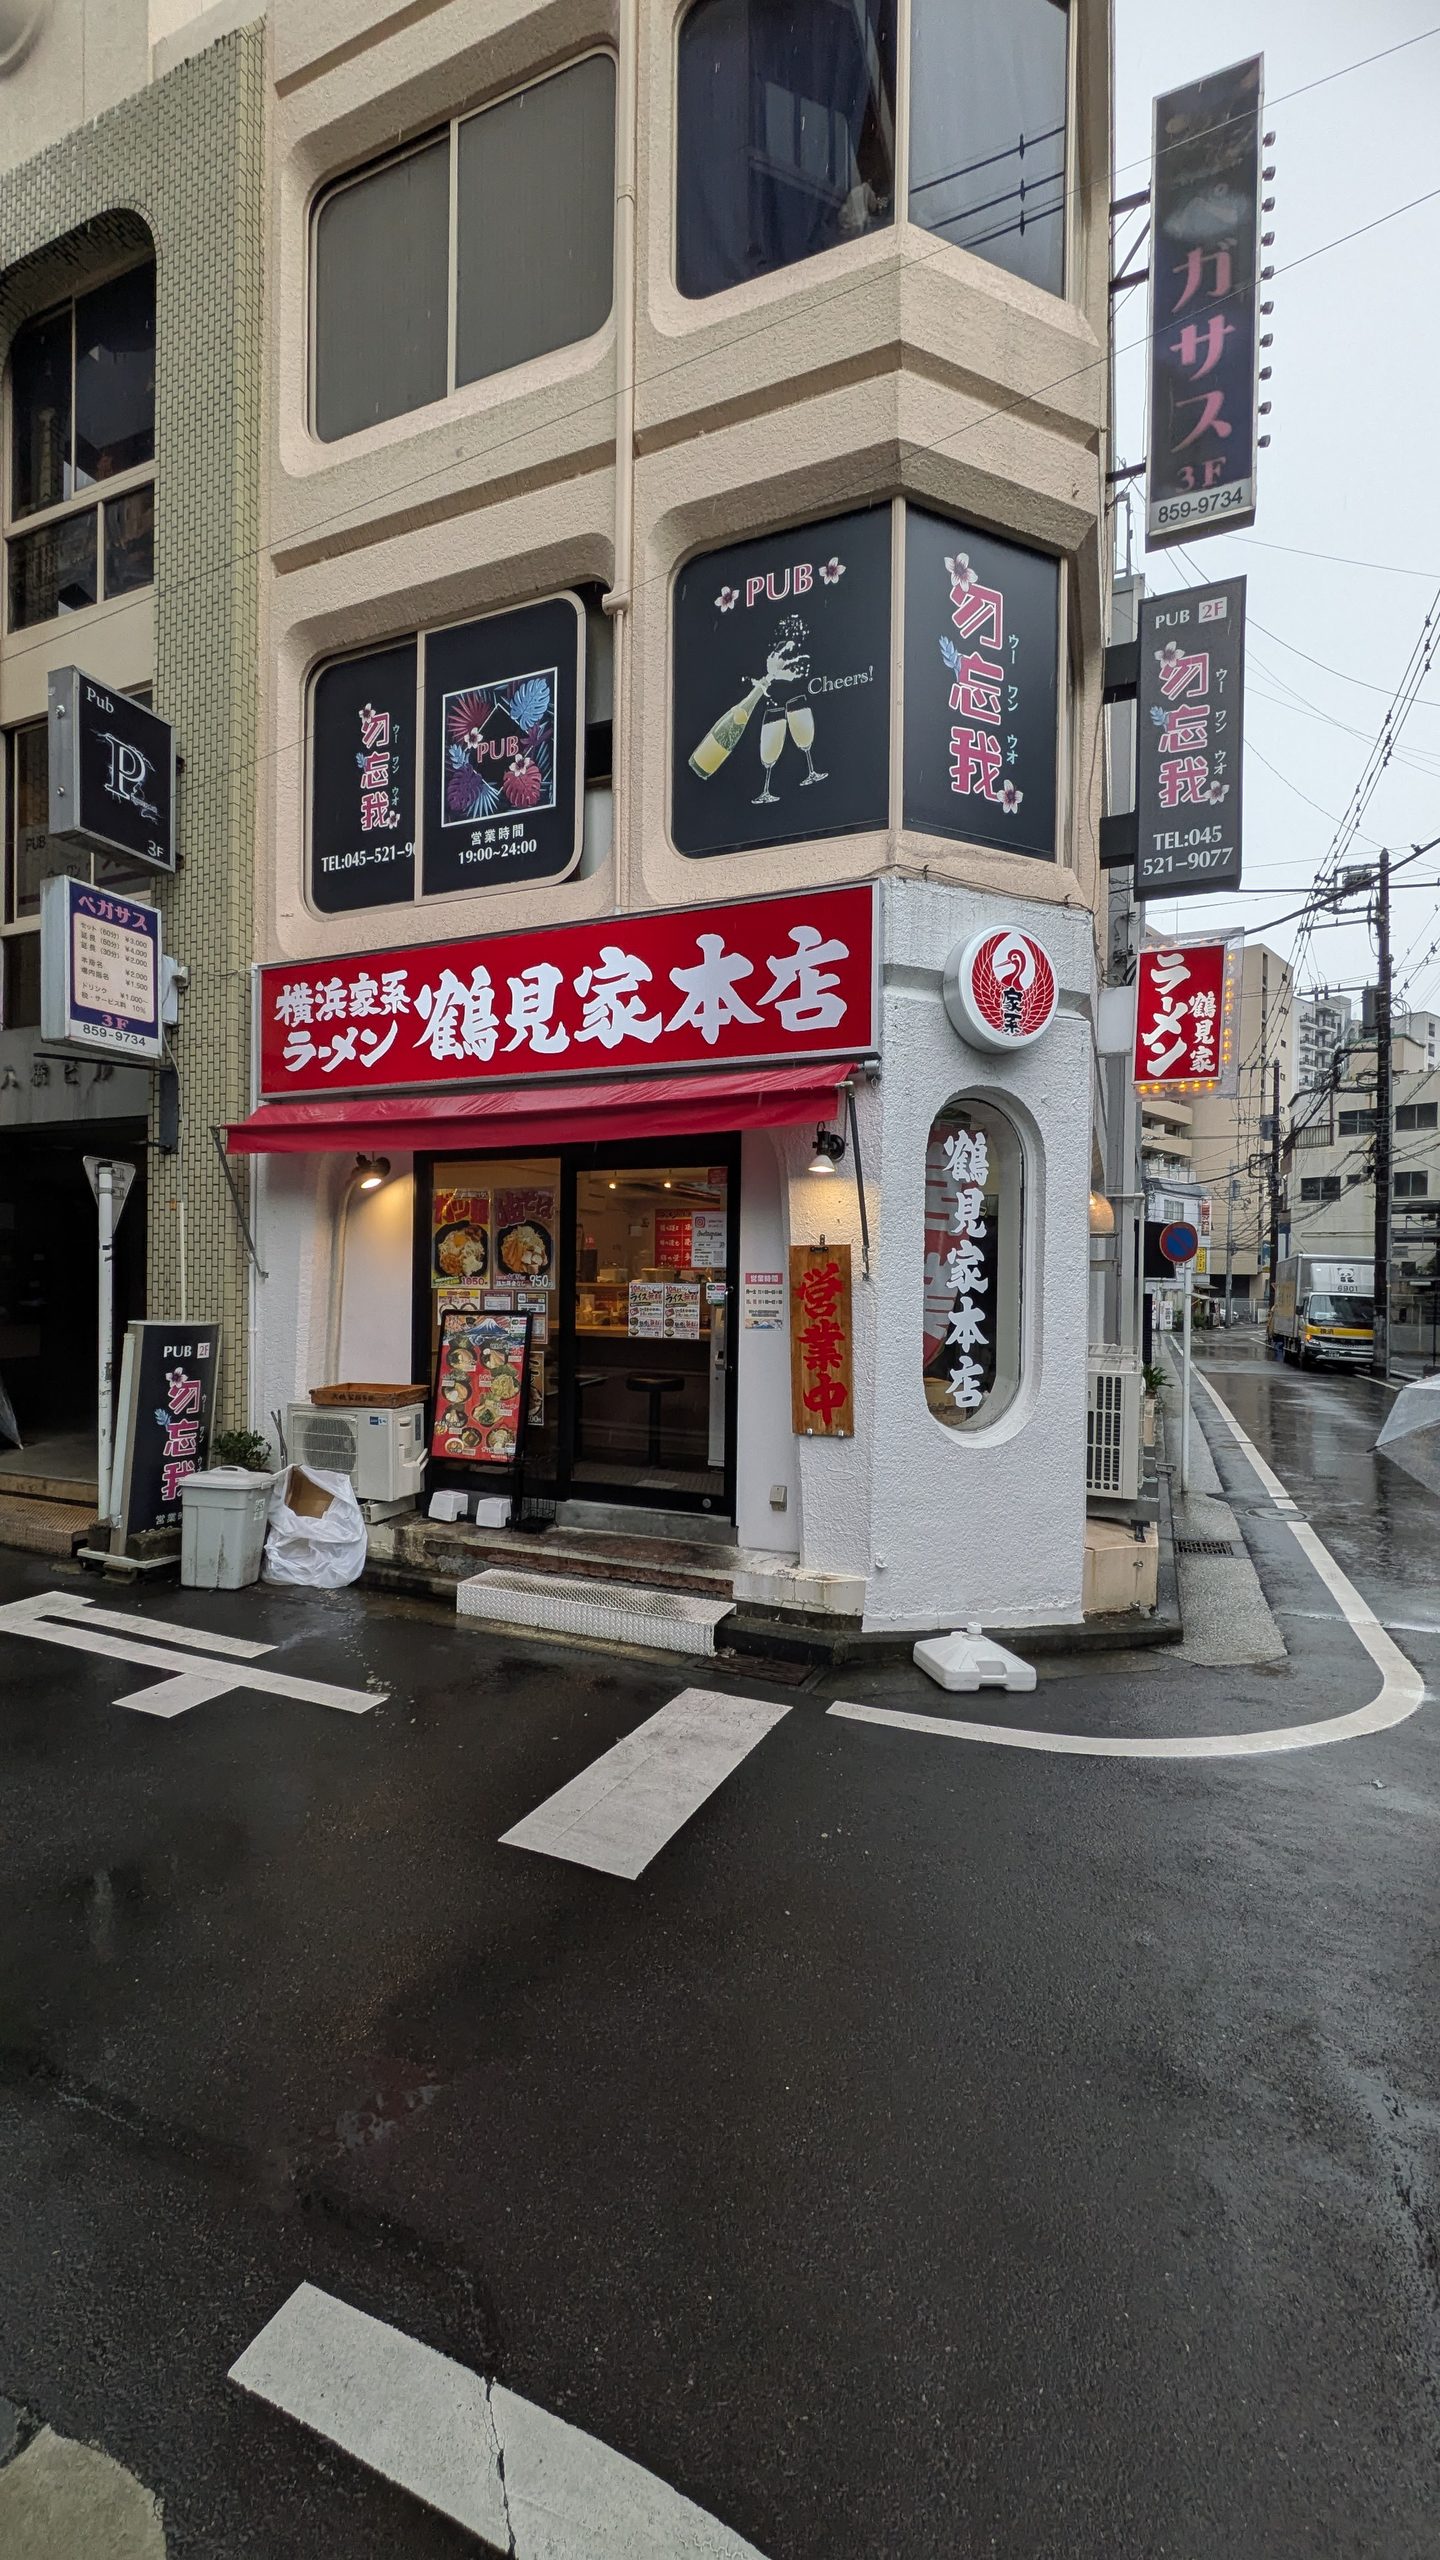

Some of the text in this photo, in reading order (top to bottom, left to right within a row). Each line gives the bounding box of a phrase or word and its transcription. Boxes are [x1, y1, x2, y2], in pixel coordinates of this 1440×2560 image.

[1175, 456, 1226, 494] 3F
[1158, 486, 1244, 524] 859-9734
[745, 563, 814, 608] PUB
[1155, 601, 1224, 629] PUB 2F
[807, 665, 874, 697] Cheers!
[949, 582, 1004, 802] 勿忘我
[86, 686, 115, 713] Pub
[1158, 652, 1210, 808] 勿忘我
[476, 735, 520, 763] PUB
[361, 711, 390, 831] 勿忘我
[147, 840, 164, 857] 3F
[470, 823, 524, 846] 営業時間
[1153, 825, 1223, 852] TEL:045
[458, 838, 538, 866] 19:00~24:00
[1143, 847, 1234, 877] 521-9077
[78, 895, 148, 932] ペガサス
[82, 982, 107, 994] ドリンク
[273, 969, 412, 1027] 横浜家系
[413, 924, 851, 1063] 鶴見家本店
[100, 1014, 129, 1031] 3F
[1141, 953, 1192, 1077] ラーメン
[1187, 991, 1217, 1073] 鶴見家
[83, 1024, 146, 1046] 859-9734
[282, 1020, 398, 1073] ラーメン
[943, 1130, 990, 1409] 鶴見家本店
[1337, 1285, 1358, 1293] 6901
[163, 1344, 209, 1358] PUB 2F
[794, 1262, 849, 1425] 営業中
